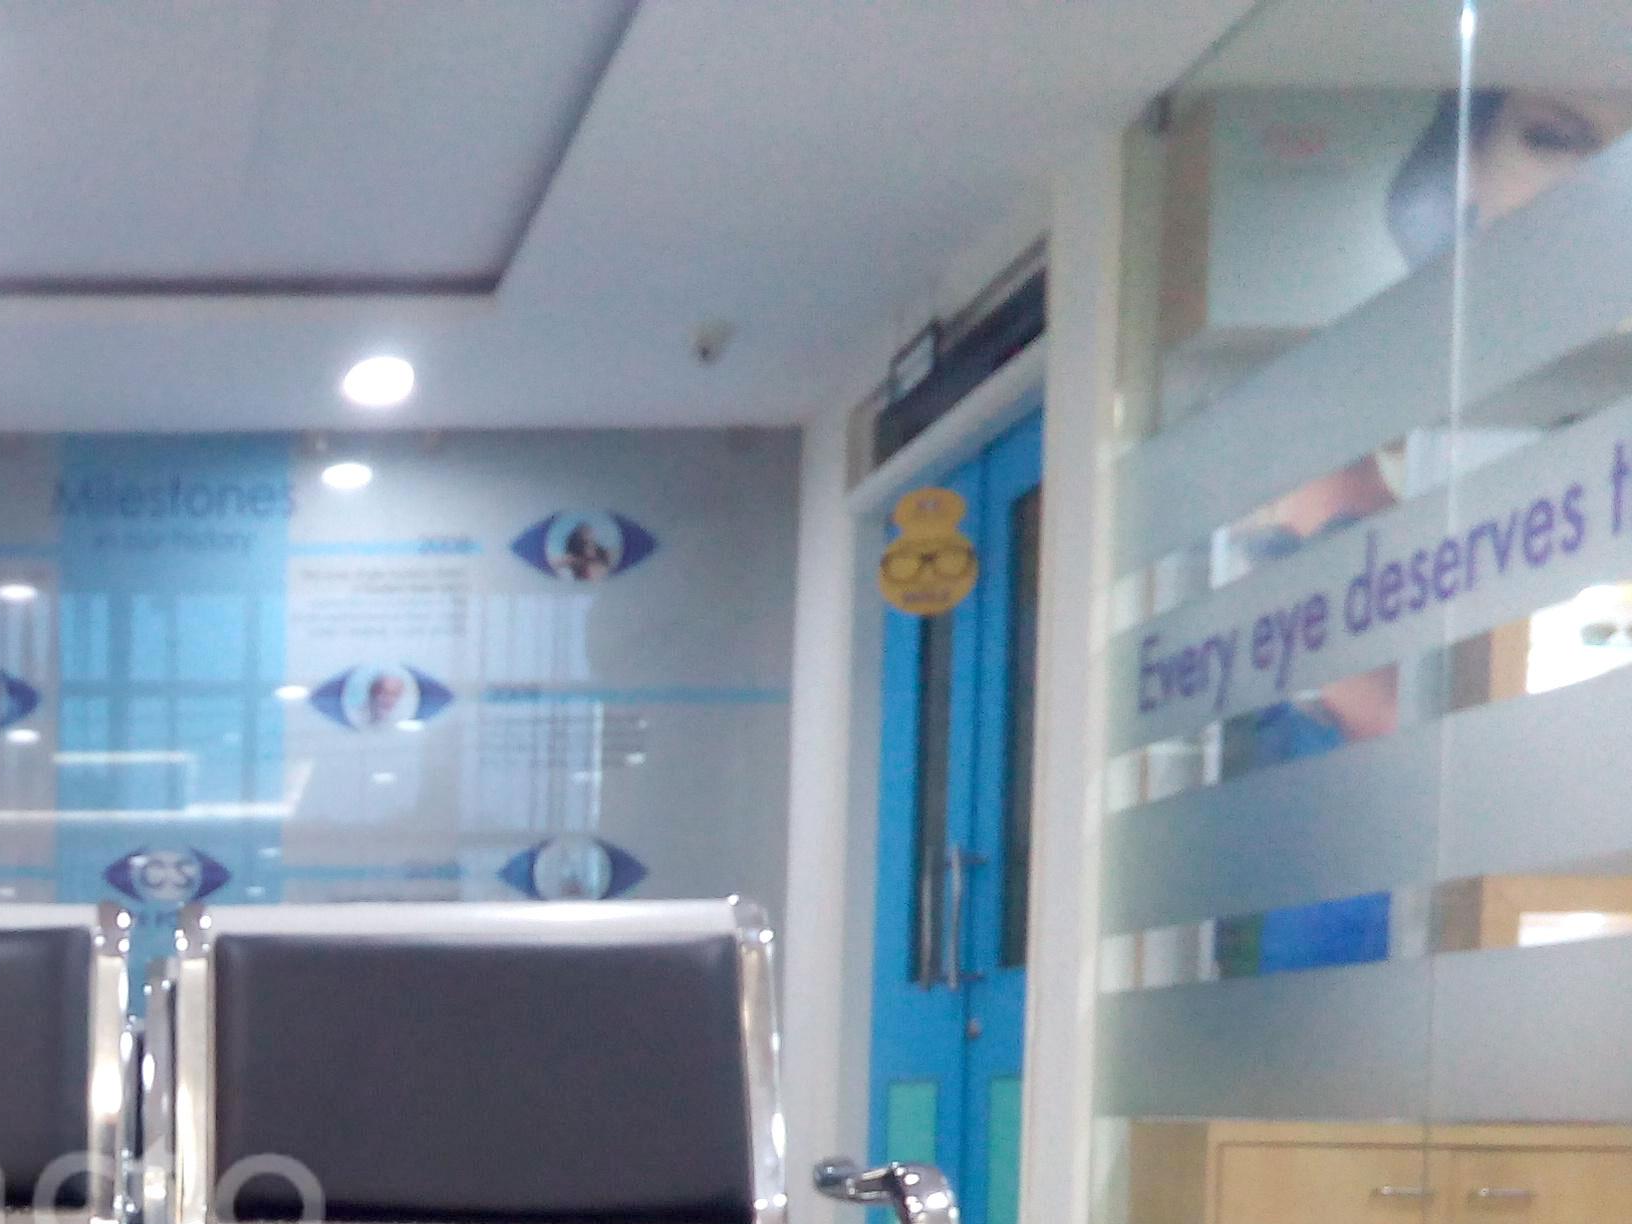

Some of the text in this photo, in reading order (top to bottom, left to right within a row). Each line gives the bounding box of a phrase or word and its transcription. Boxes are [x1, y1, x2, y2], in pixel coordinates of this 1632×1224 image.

[49, 475, 297, 519] Milestones
[1138, 625, 1237, 715] Every
[1250, 591, 1330, 690] eye
[1342, 483, 1586, 636] deserves
